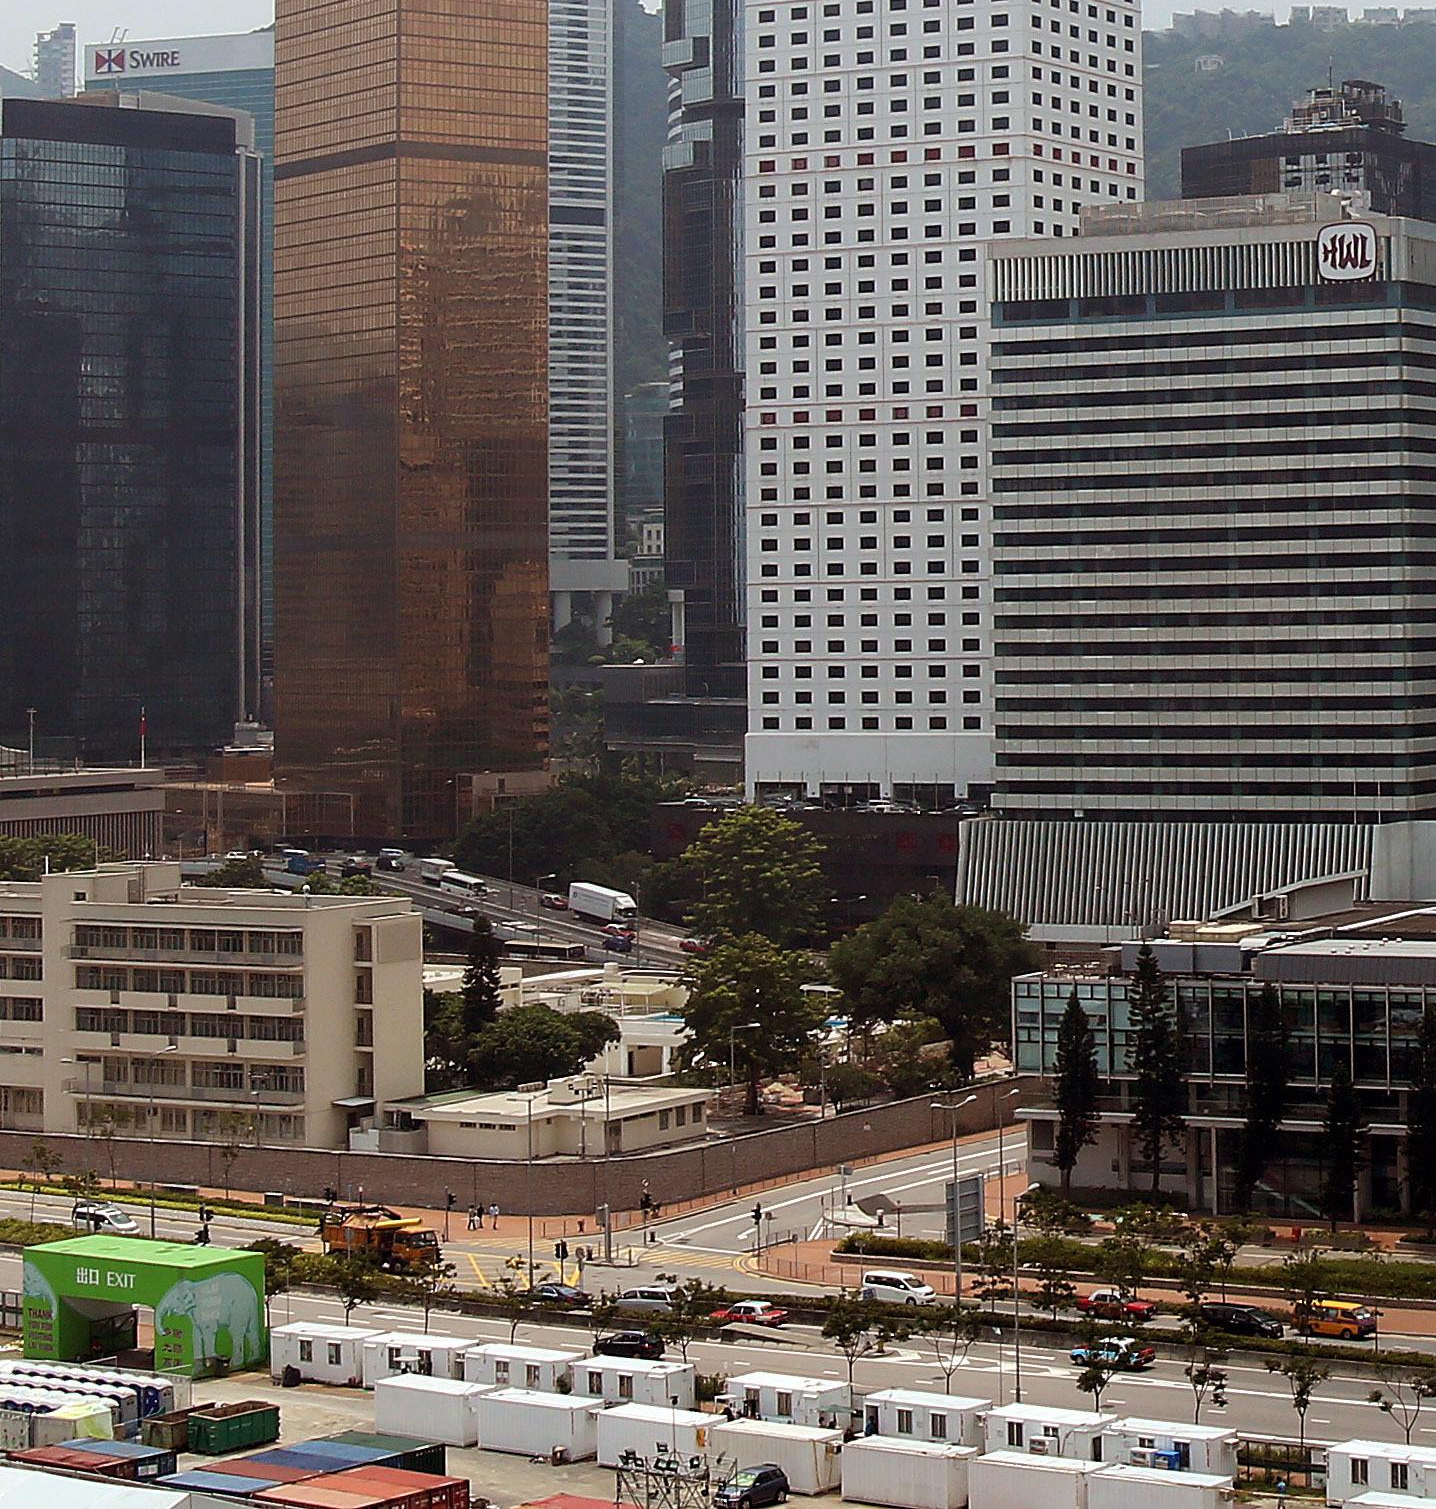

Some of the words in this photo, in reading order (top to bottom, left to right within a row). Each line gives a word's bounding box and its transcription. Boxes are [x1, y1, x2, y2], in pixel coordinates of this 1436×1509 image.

[1322, 233, 1373, 270] HWL
[76, 1267, 99, 1285] 出口
[107, 1271, 137, 1288] EXIT
